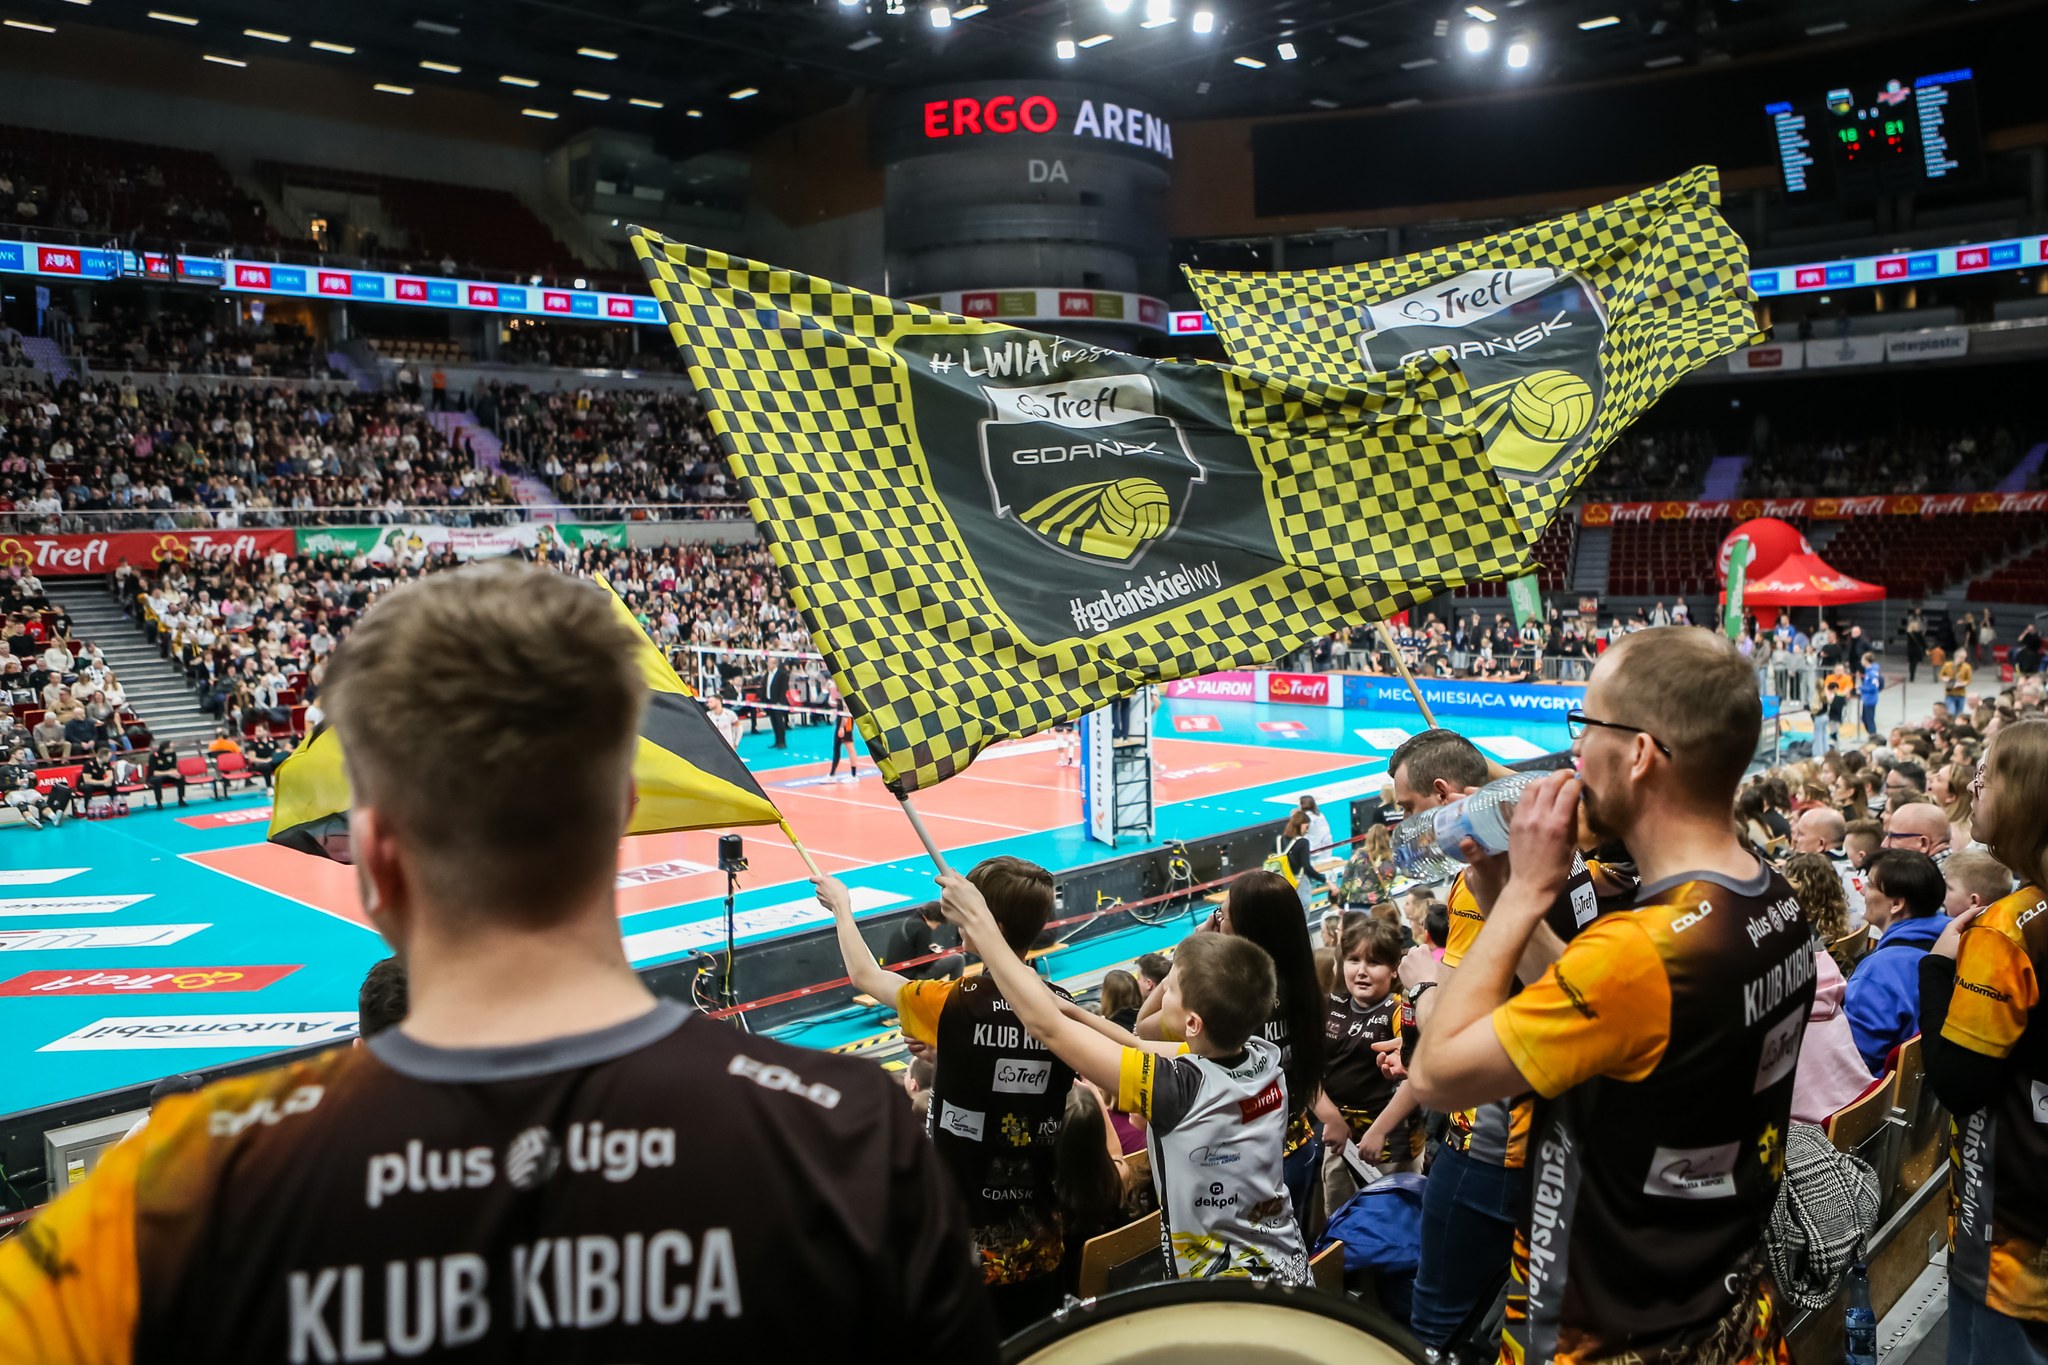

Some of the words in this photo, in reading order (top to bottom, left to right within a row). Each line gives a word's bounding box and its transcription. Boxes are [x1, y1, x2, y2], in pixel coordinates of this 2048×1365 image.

[924, 95, 1058, 139] ERGO
[1072, 99, 1174, 159] ARENA
[1885, 120, 1904, 136] 21
[1028, 159, 1069, 183] DA
[1436, 271, 1514, 318] Trefl
[1045, 386, 1119, 422] Trefl
[1610, 503, 1652, 522] Trefl
[1685, 502, 1730, 520] Trefl
[1762, 501, 1806, 518] Trefl
[1839, 497, 1885, 516] Trefl
[1919, 496, 1967, 515] Trefl
[1999, 493, 2048, 513] Trefl
[34, 539, 108, 571] Trefl
[1070, 560, 1222, 632] #gdańskielwy
[1196, 679, 1252, 696] TAURON
[1290, 679, 1326, 699] Trefl
[1426, 690, 1506, 709] MIESIĄCA
[38, 776, 69, 788] ARENA
[1671, 900, 1713, 933] COLO
[1745, 917, 1772, 948] plus
[1775, 896, 1801, 922] liga
[30, 973, 176, 991] Trefl
[1743, 971, 1783, 1028] KLUB
[1785, 934, 1818, 998] KIBIC
[84, 1020, 324, 1040] Automobil
[973, 1023, 1020, 1050] KLUB
[1016, 1066, 1047, 1087] Trefl
[366, 1140, 496, 1208] plus
[568, 1122, 676, 1183] liga
[1194, 1193, 1239, 1209] dekpol
[286, 1253, 490, 1365] KLUB
[513, 1228, 742, 1331] KIBICA
